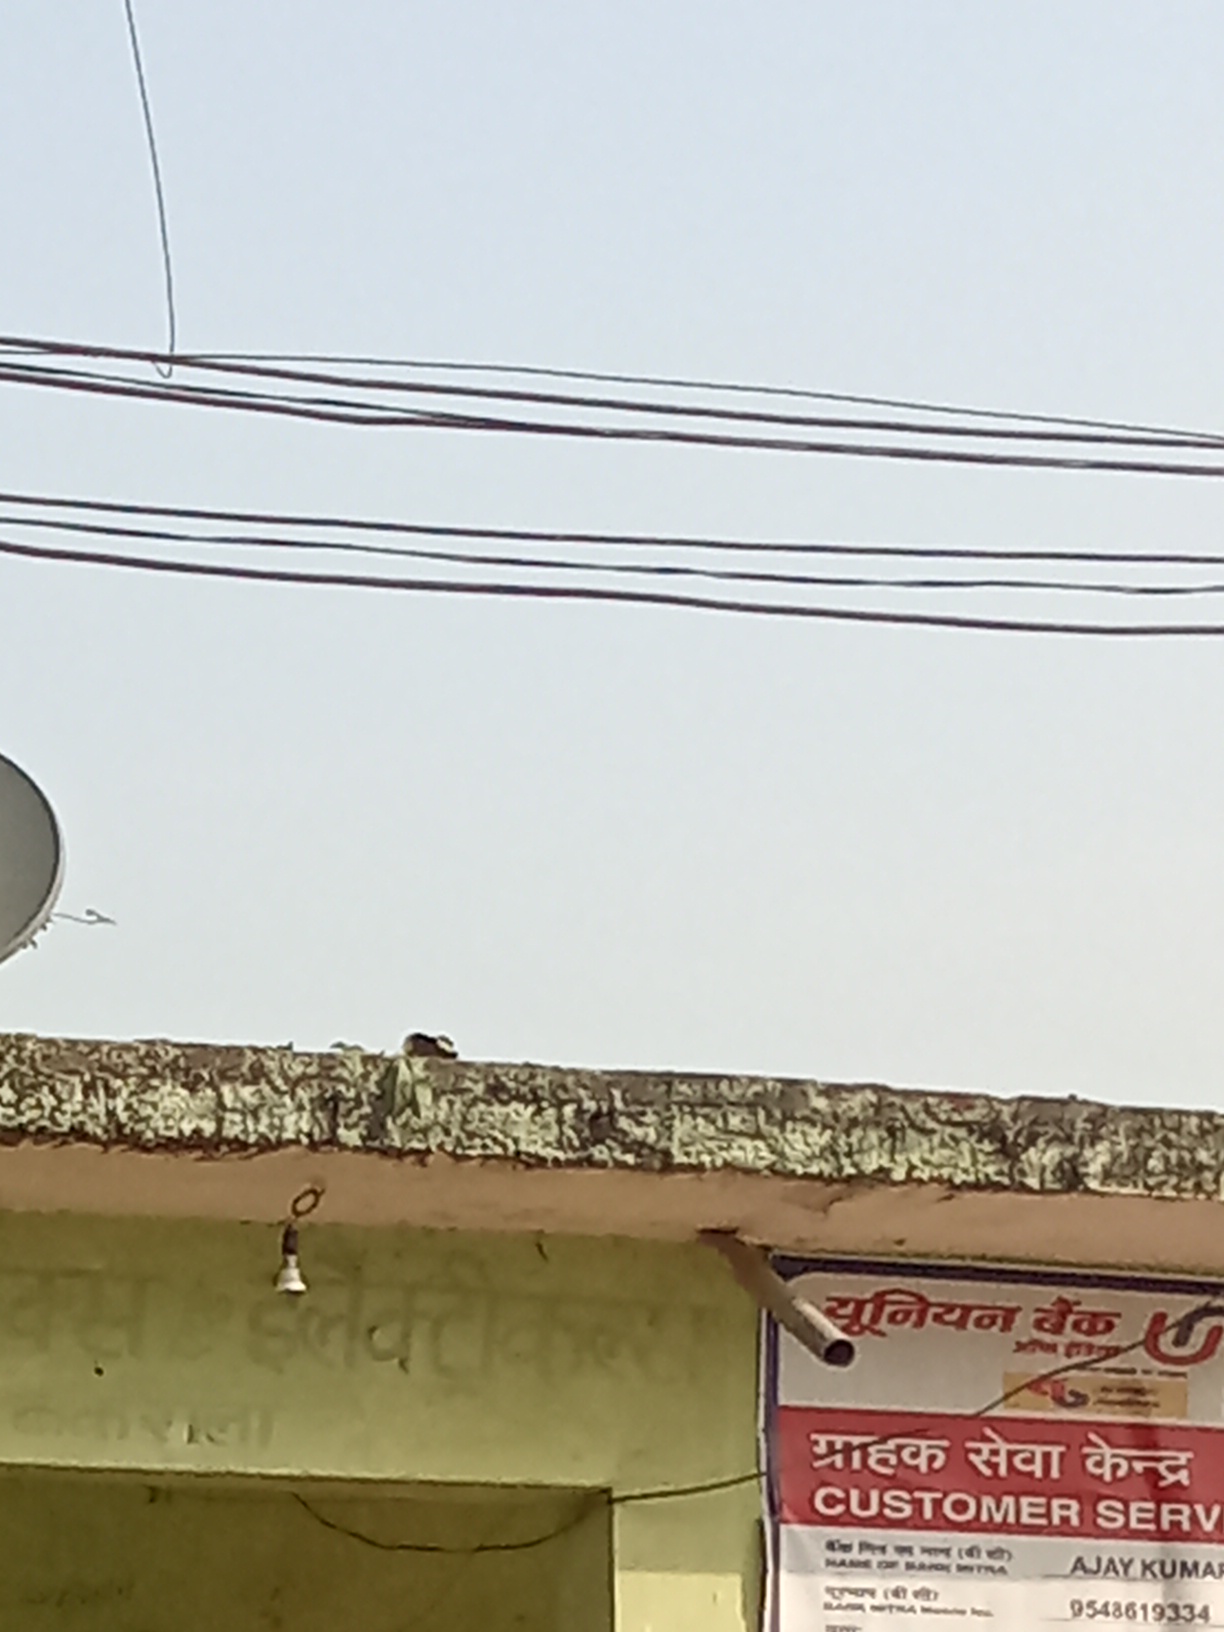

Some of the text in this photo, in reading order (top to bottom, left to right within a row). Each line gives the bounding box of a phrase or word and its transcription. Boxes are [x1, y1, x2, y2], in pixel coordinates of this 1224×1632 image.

[824, 1288, 1122, 1338] यूनियन बैंक
[809, 1428, 1194, 1487] ग्राहक सेवा केन्द्र
[813, 1487, 1224, 1532] CUSTOMER SERV
[1070, 1556, 1135, 1577] AJAY
